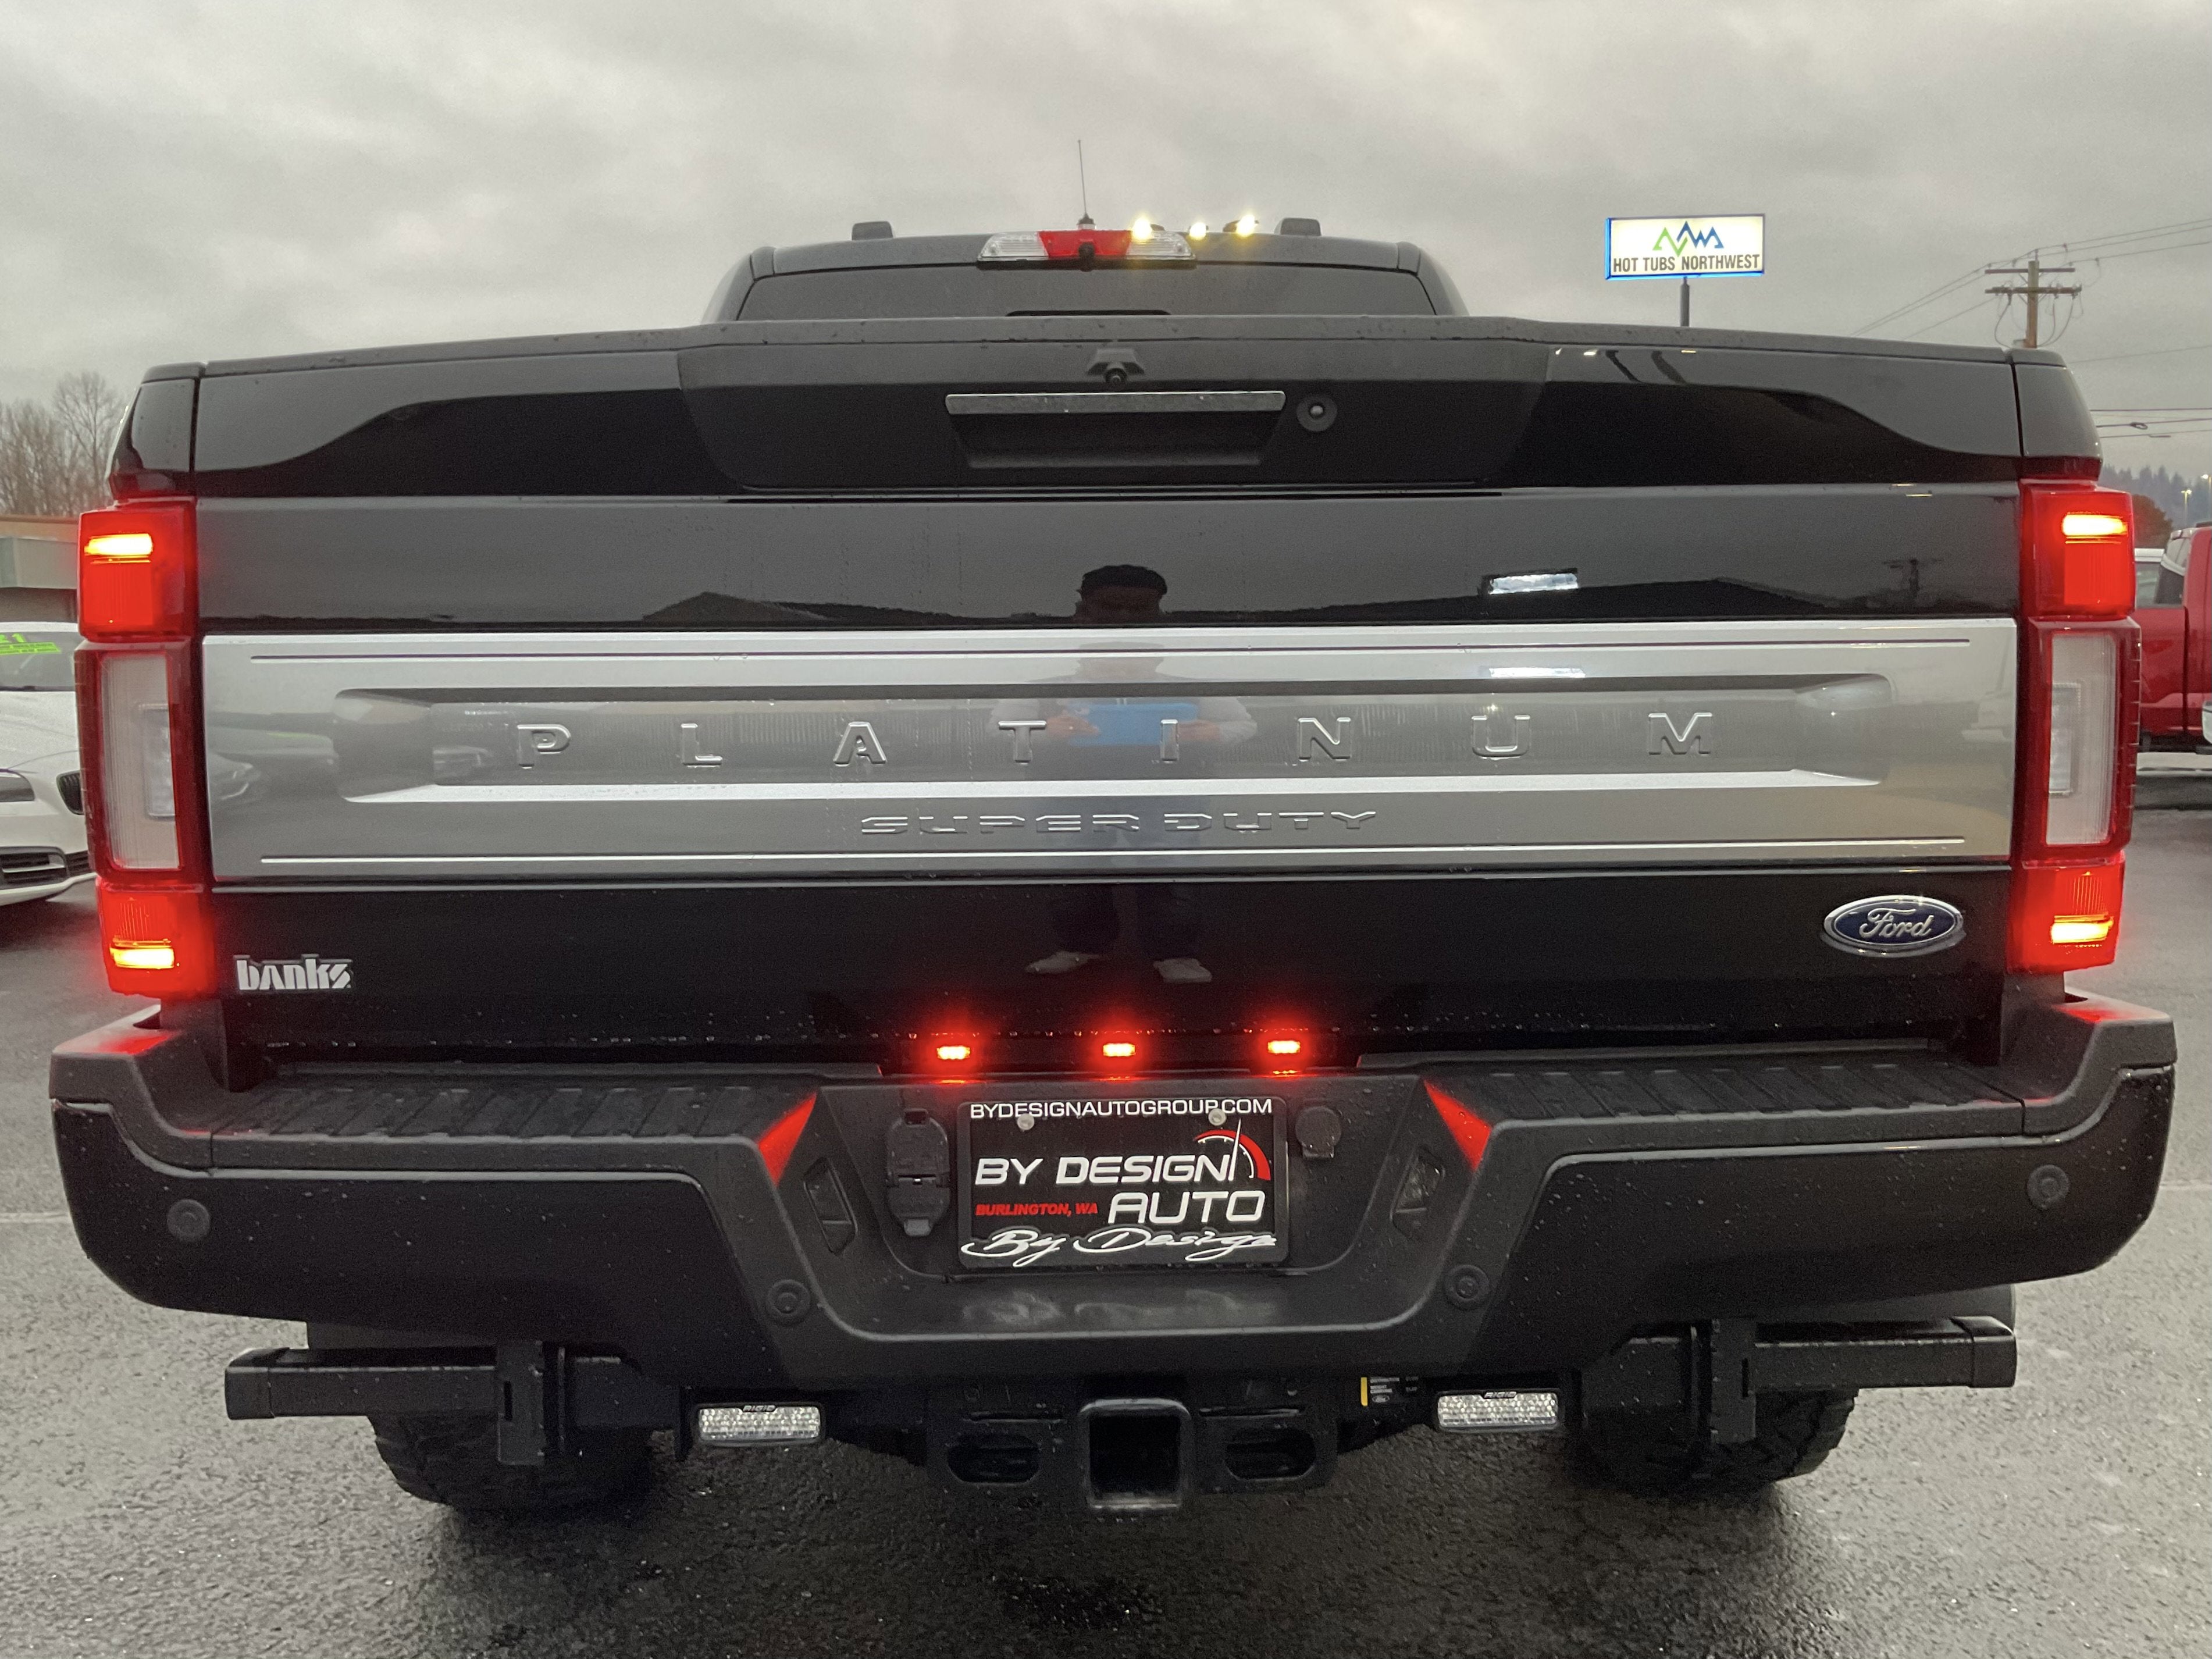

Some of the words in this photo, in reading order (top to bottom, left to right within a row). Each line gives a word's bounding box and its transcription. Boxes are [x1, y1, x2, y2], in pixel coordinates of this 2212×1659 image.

[1613, 258, 1638, 272] HOT
[1643, 257, 1676, 271] TUBS
[1681, 254, 1760, 270] NORTHWEST
[517, 713, 1713, 768] PLATINUM
[861, 814, 1140, 834] SUPER
[1163, 811, 1377, 832] DUTY
[1859, 907, 1935, 938] Ford
[235, 957, 352, 990] banks
[970, 1098, 1273, 1119] BYDESIGNAUTOGROUPCOM
[975, 1158, 1043, 1184] BY
[1056, 1155, 1230, 1184] DESIGN
[975, 1203, 1072, 1217] BURLINGTON,
[1075, 1202, 1098, 1215] WA
[1107, 1190, 1265, 1223] AUTO
[960, 1229, 1067, 1267] By
[1073, 1227, 1277, 1261] Design
